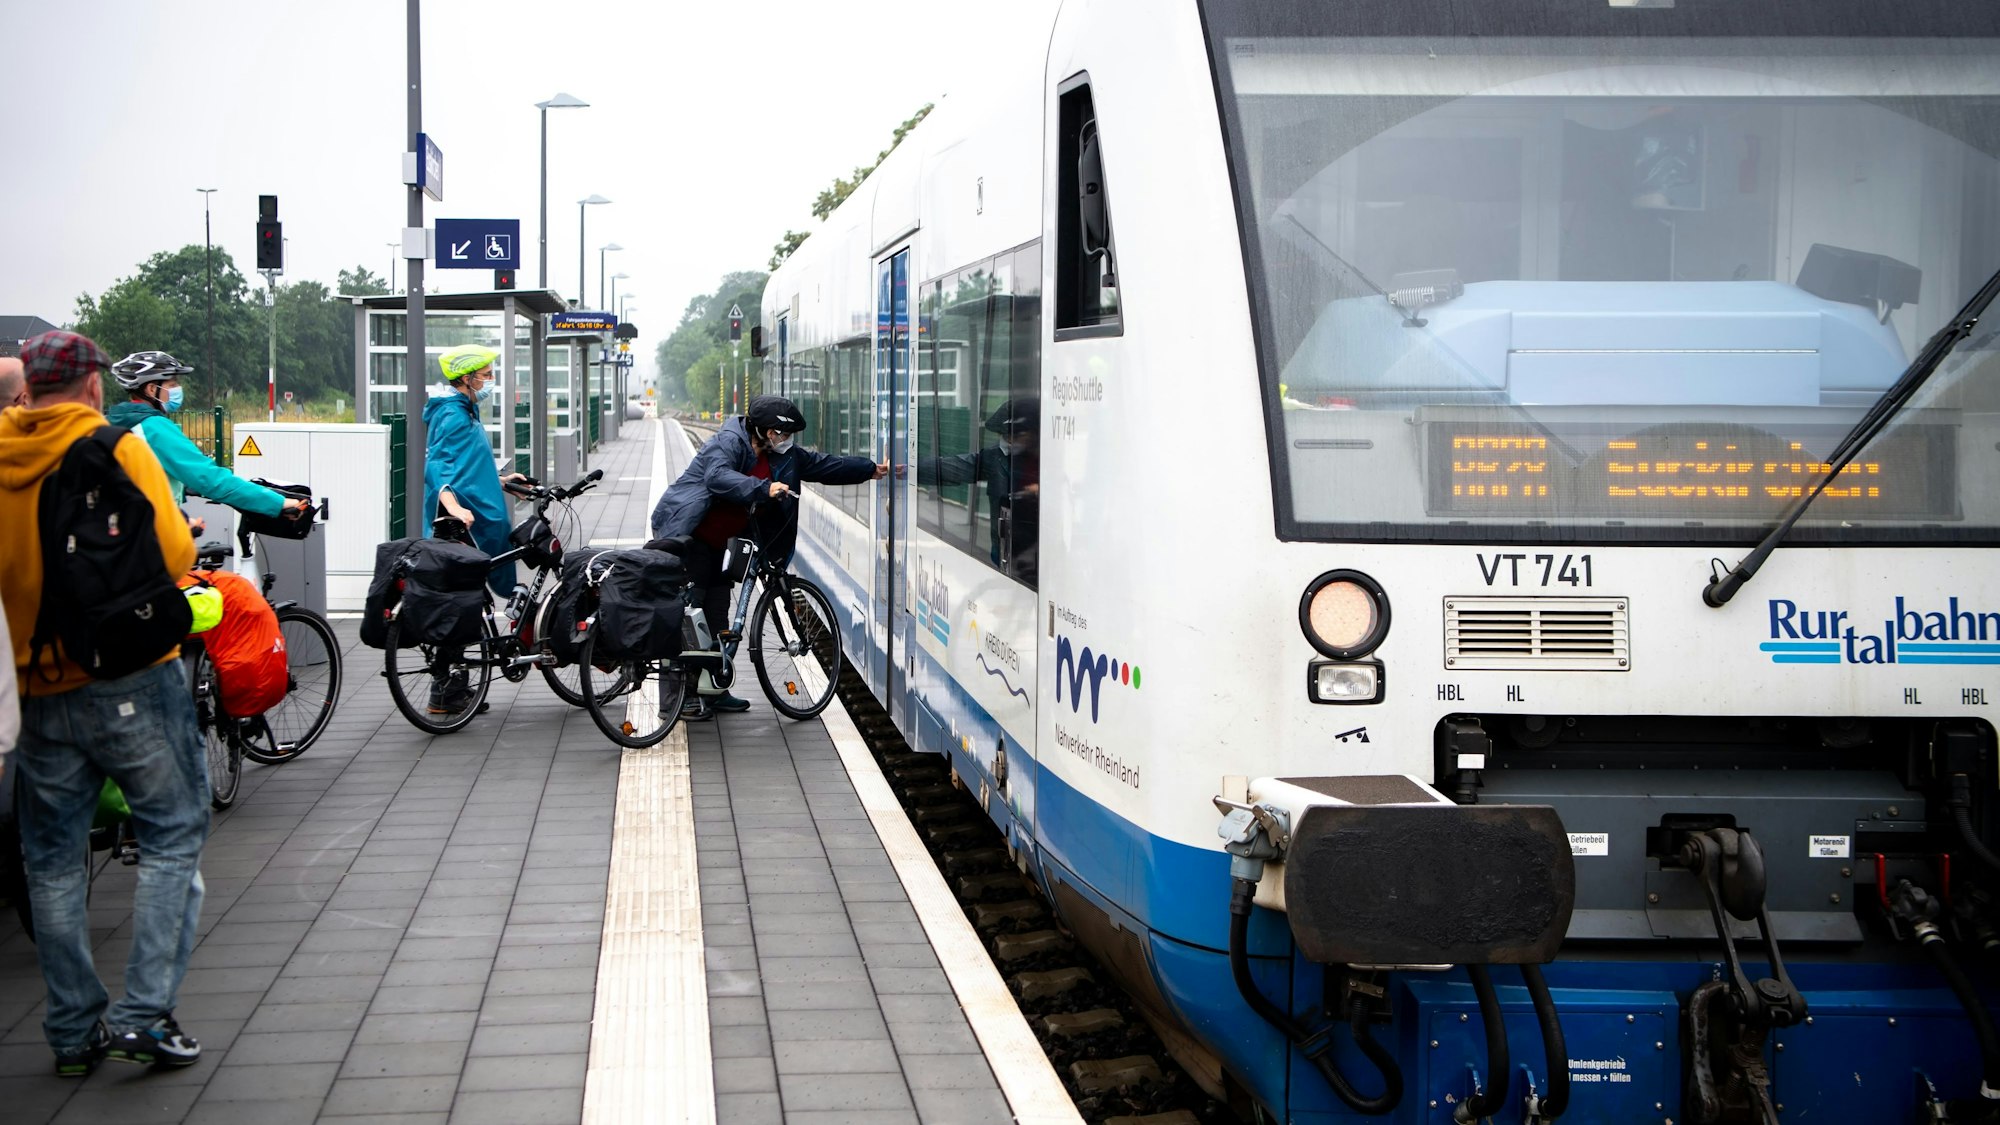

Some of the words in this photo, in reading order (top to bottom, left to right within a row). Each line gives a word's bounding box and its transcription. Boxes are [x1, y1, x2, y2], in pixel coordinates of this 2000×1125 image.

[1053, 376, 1103, 407] RegioShuttle
[1052, 416, 1061, 440] VT
[1063, 416, 1075, 440] 741
[1476, 553, 1526, 586] VT
[1535, 554, 1593, 587] 741
[985, 630, 1000, 657] KREIS
[1000, 641, 1021, 675] DÜREN
[1437, 684, 1465, 701] HBL
[1507, 685, 1525, 702] HL
[1904, 688, 1922, 705] HL
[1962, 688, 1989, 705] HBL
[1055, 723, 1093, 763] Nahverkehr
[1095, 746, 1140, 789] Rheinland
[1570, 834, 1605, 844] Getriebeöl
[1813, 837, 1846, 846] Motorenöl
[1571, 845, 1588, 854] üllen
[1820, 847, 1839, 856] füllen
[1568, 1059, 1626, 1070] Umlenkgetriebe
[1572, 1072, 1601, 1082] messen
[1610, 1072, 1631, 1082] füllen
